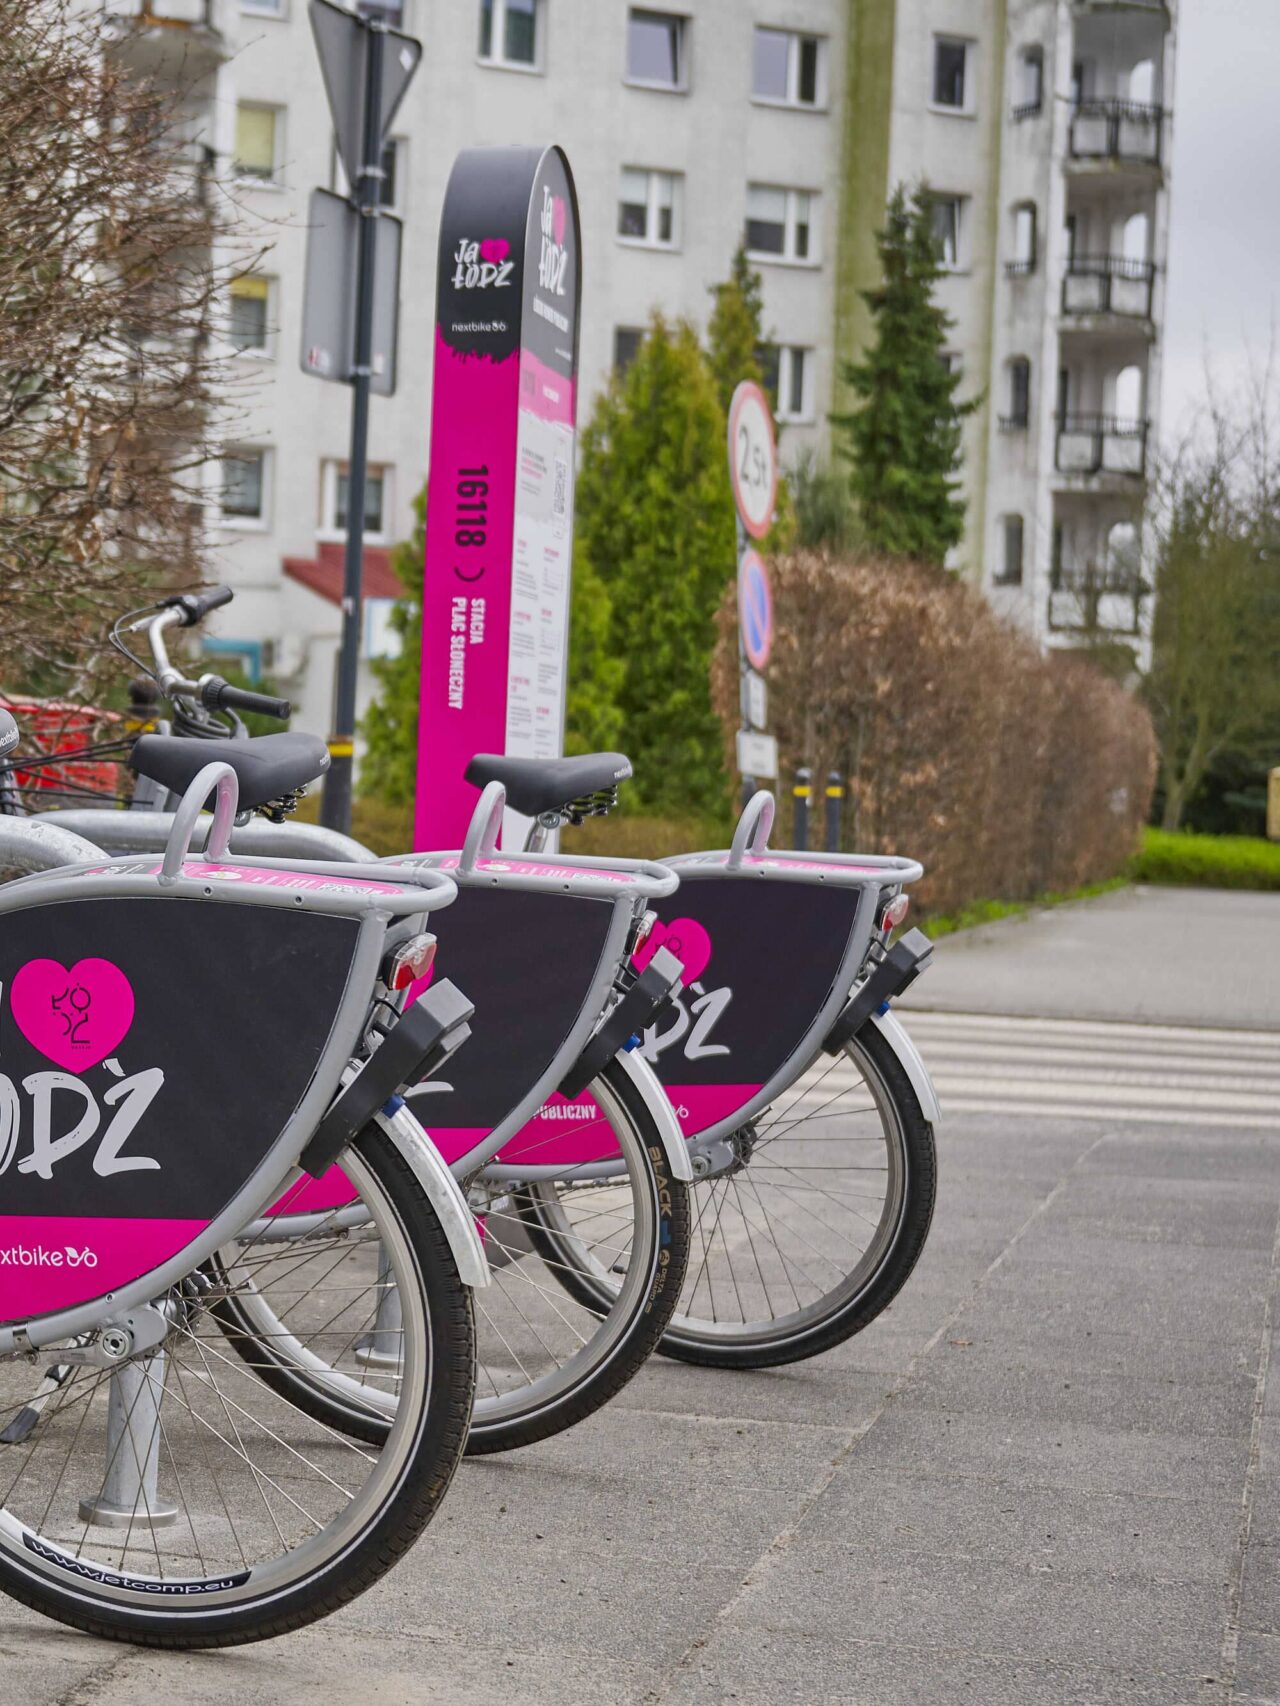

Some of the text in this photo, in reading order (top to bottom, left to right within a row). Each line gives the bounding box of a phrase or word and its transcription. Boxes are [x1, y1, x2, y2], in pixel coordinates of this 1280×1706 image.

[454, 238, 480, 264] Ja
[451, 321, 491, 333] nextbike
[454, 464, 489, 548] 16118
[470, 597, 486, 645] STACJA
[448, 597, 467, 710] PLAC SŁONECZNY
[31, 1541, 234, 1594] www.jetcomp.eu
